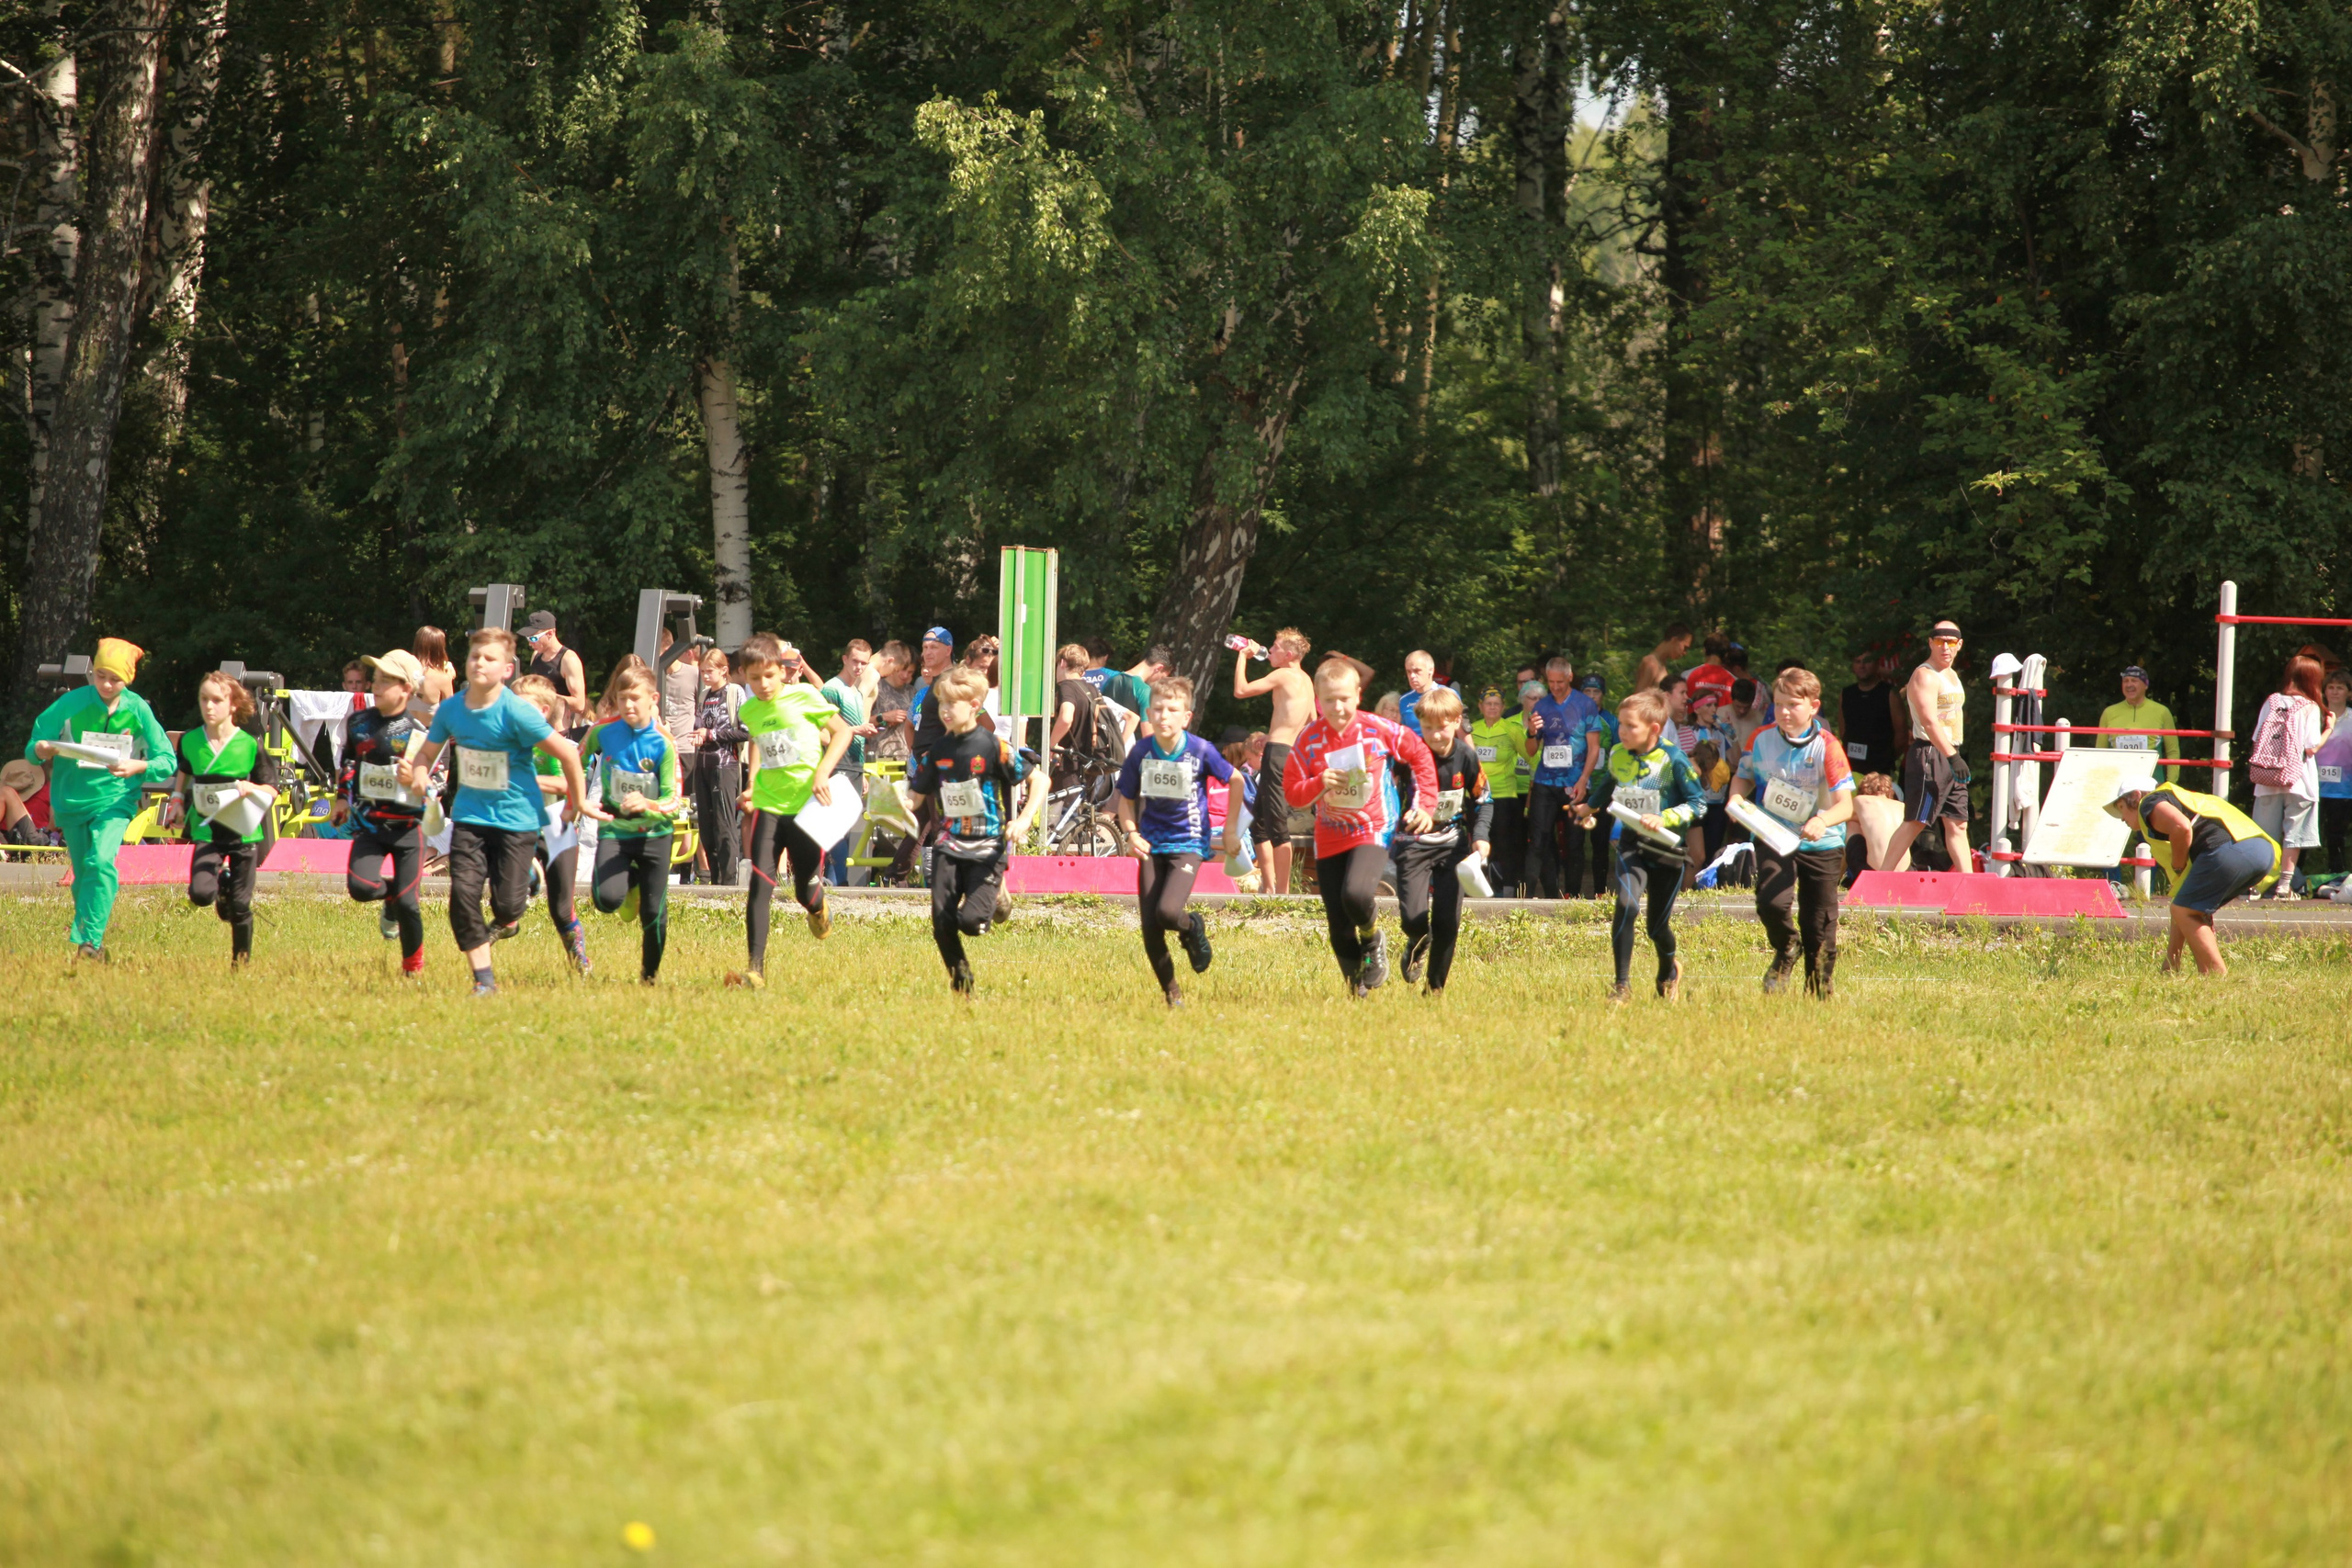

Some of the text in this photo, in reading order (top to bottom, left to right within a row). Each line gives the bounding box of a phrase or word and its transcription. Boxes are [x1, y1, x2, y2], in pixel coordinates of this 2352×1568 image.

[765, 743, 786, 757] 654
[469, 764, 491, 778] 647
[2321, 768, 2337, 777] 915
[369, 777, 393, 789] 646
[1154, 773, 1177, 786] 656
[620, 782, 643, 794] 653
[946, 795, 967, 807] 655
[1624, 797, 1645, 809] 637
[1775, 794, 1798, 811] 658
